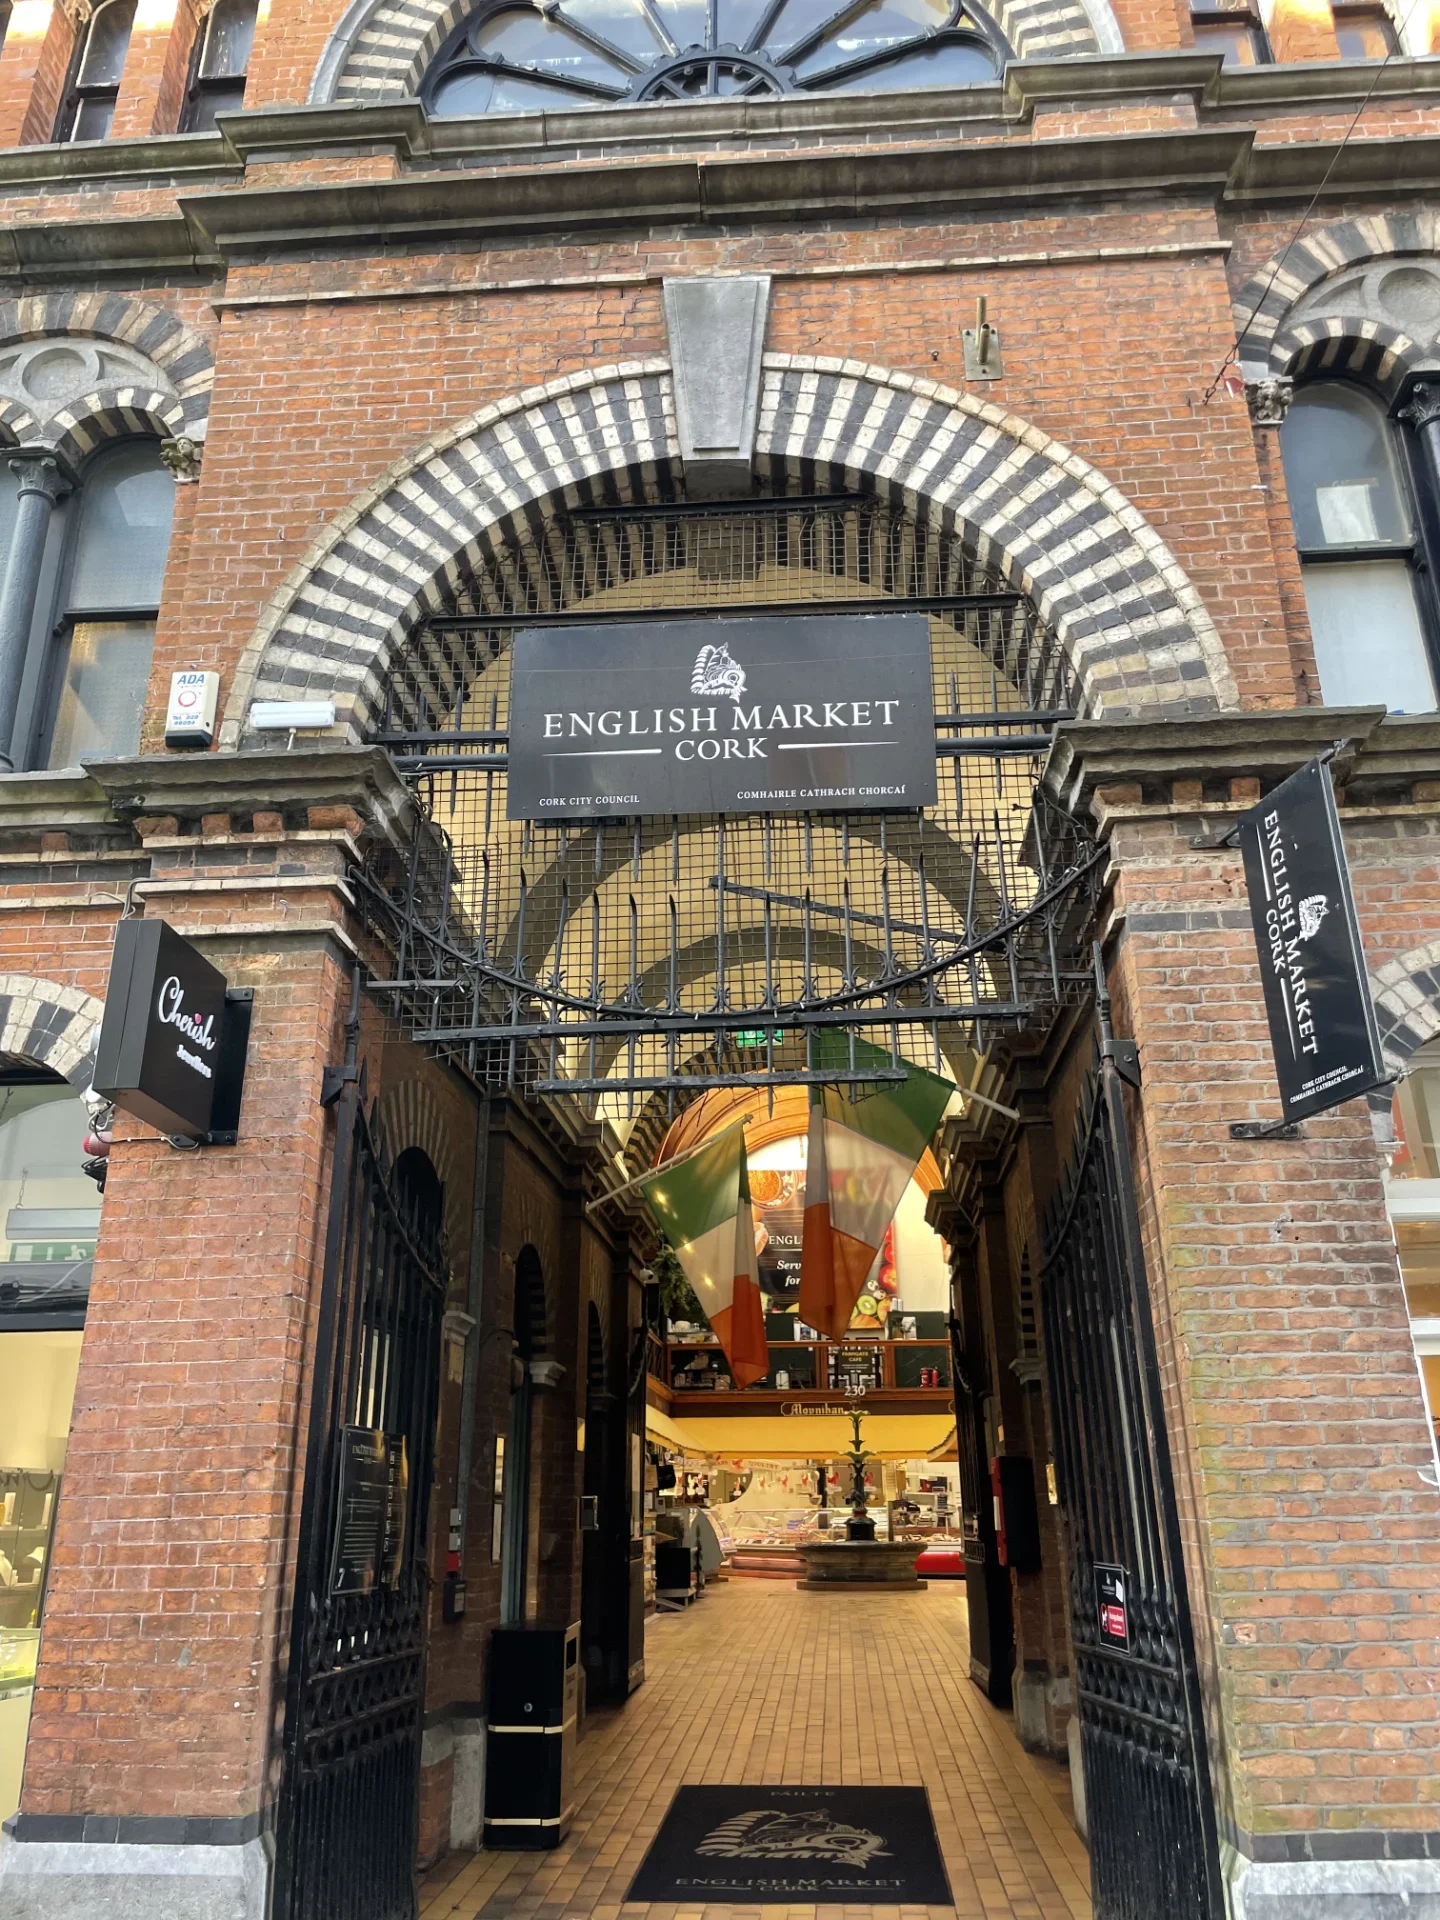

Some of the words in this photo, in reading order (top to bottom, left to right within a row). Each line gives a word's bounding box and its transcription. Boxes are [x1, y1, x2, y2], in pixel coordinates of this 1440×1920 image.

[177, 674, 205, 685] ADA
[542, 708, 718, 738] ENGLISH
[731, 700, 900, 731] MARKET
[675, 737, 768, 761] CORK
[737, 789, 797, 800] COMHAIRLE
[800, 787, 855, 797] CATHRACH
[859, 785, 906, 795] CHORCAÍ
[539, 798, 566, 807] CORK
[569, 797, 592, 805] CITY
[595, 795, 640, 804] COUNCIL
[1264, 809, 1297, 933] ENGLISH
[1285, 937, 1319, 1056] MARKET
[1265, 908, 1286, 975] CORK
[158, 975, 217, 1051] Cherish
[768, 1235, 803, 1245] ENGL
[844, 1385, 866, 1396] 230
[675, 1878, 788, 1887] ENGLISH
[797, 1878, 906, 1887] MARKET
